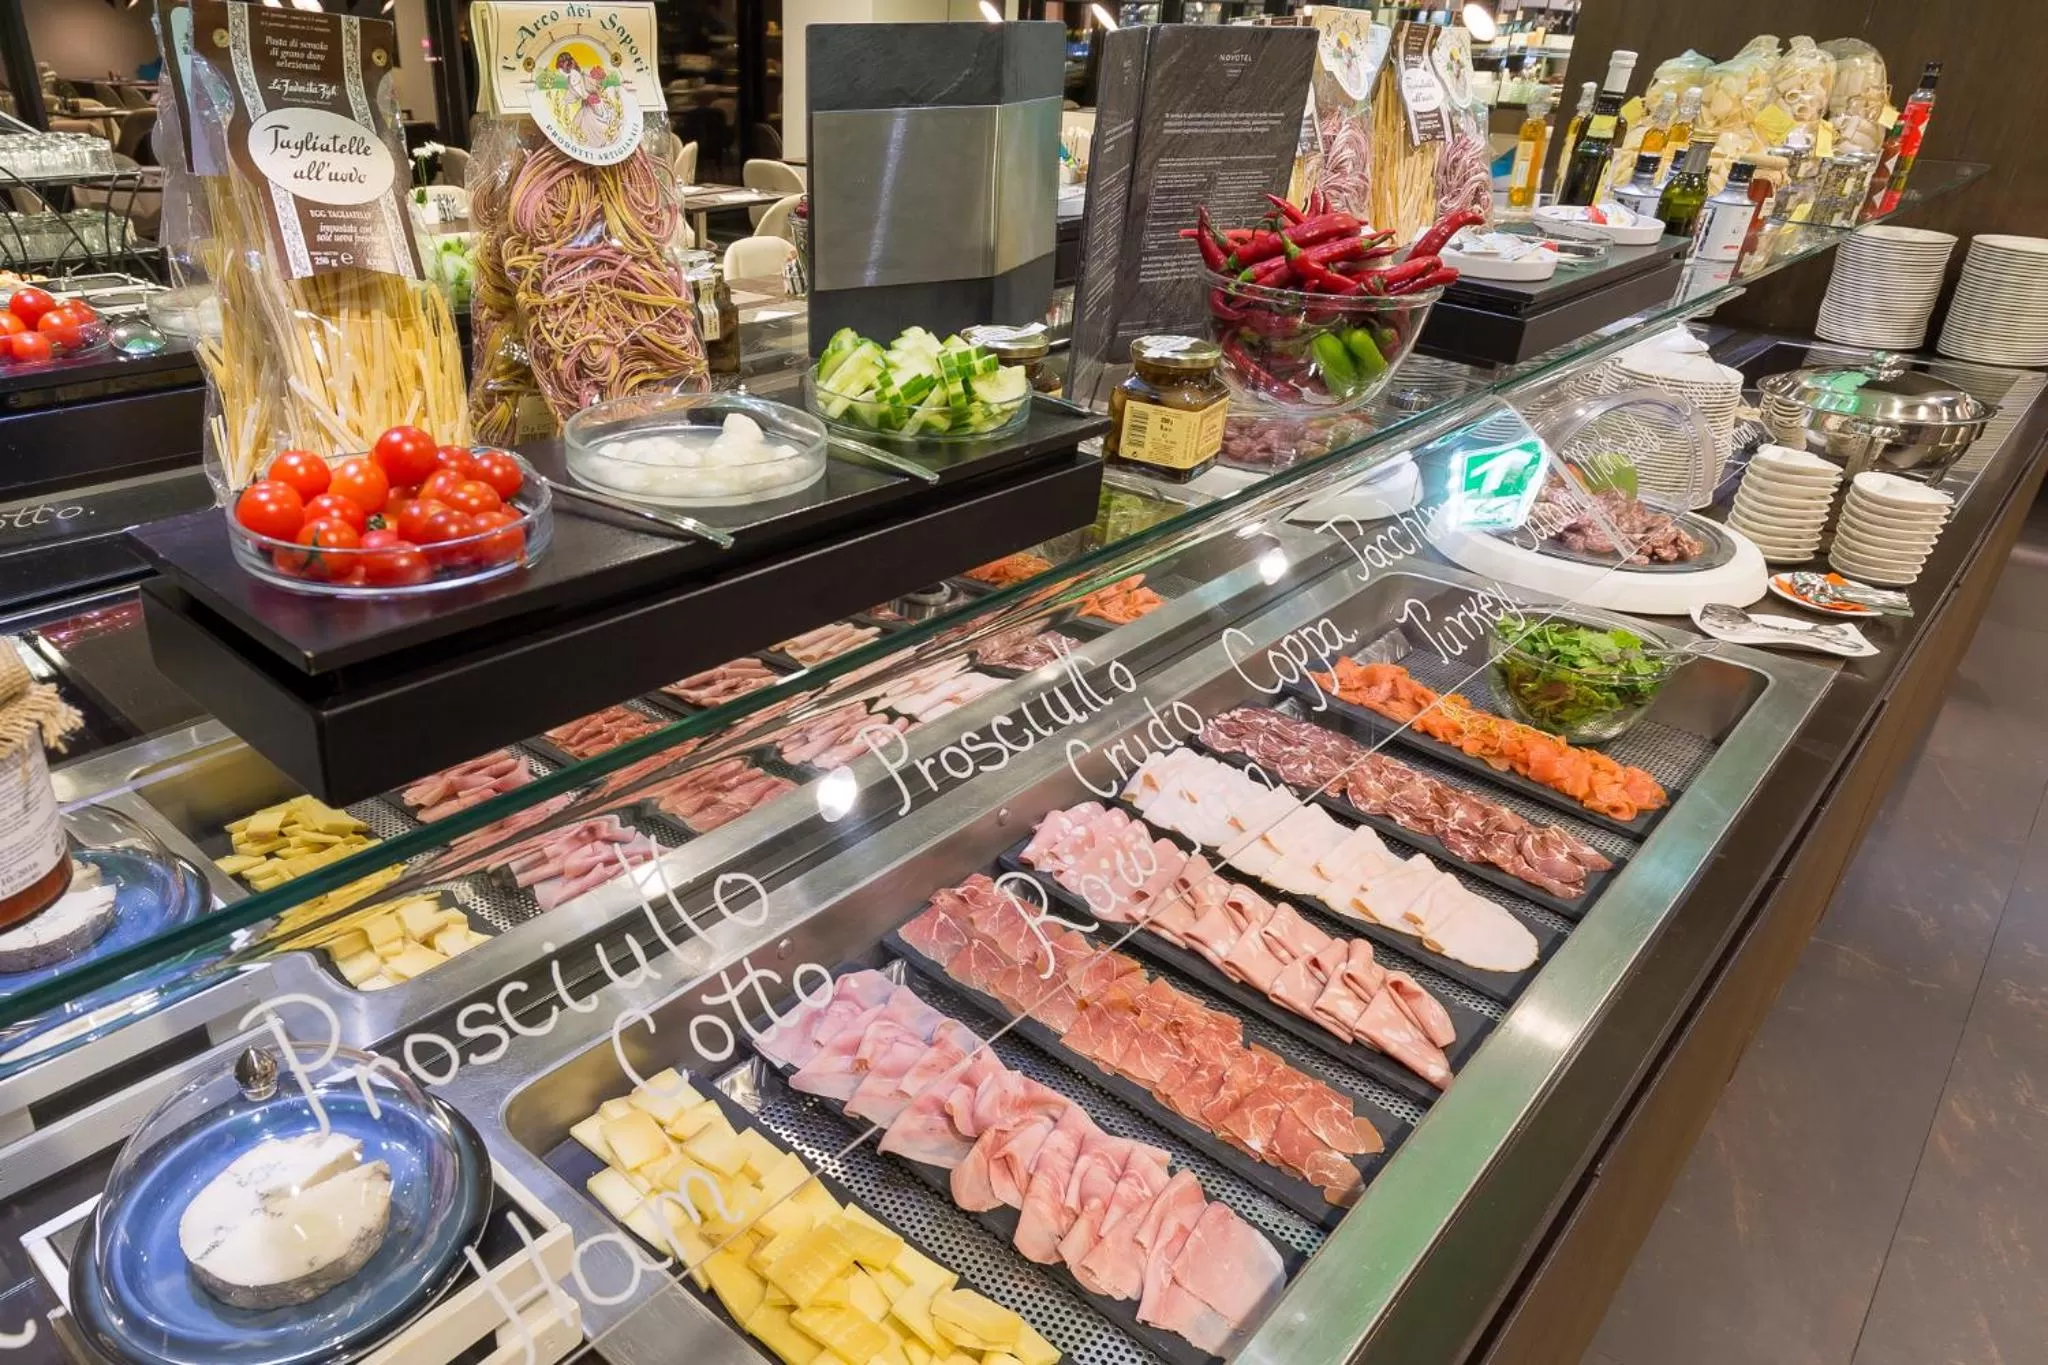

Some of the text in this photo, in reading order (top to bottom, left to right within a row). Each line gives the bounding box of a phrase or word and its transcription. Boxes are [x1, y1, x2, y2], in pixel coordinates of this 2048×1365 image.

[265, 35, 288, 47] Pasta
[288, 38, 299, 48] di
[280, 50, 305, 60] grano
[306, 50, 326, 62] duro
[567, 3, 592, 18] dei
[600, 13, 651, 74] Sapori
[1219, 53, 1253, 62] NOVOTEL
[263, 124, 372, 159] Tagliatelle
[545, 123, 594, 160] PRODOTTI
[293, 160, 367, 184] all'uovo
[859, 634, 1137, 816] Prosciutto
[1065, 697, 1204, 798] Crudo
[994, 833, 1157, 979] Raw
[240, 835, 769, 1139] Prosciutto
[613, 957, 835, 1098] Cotto
